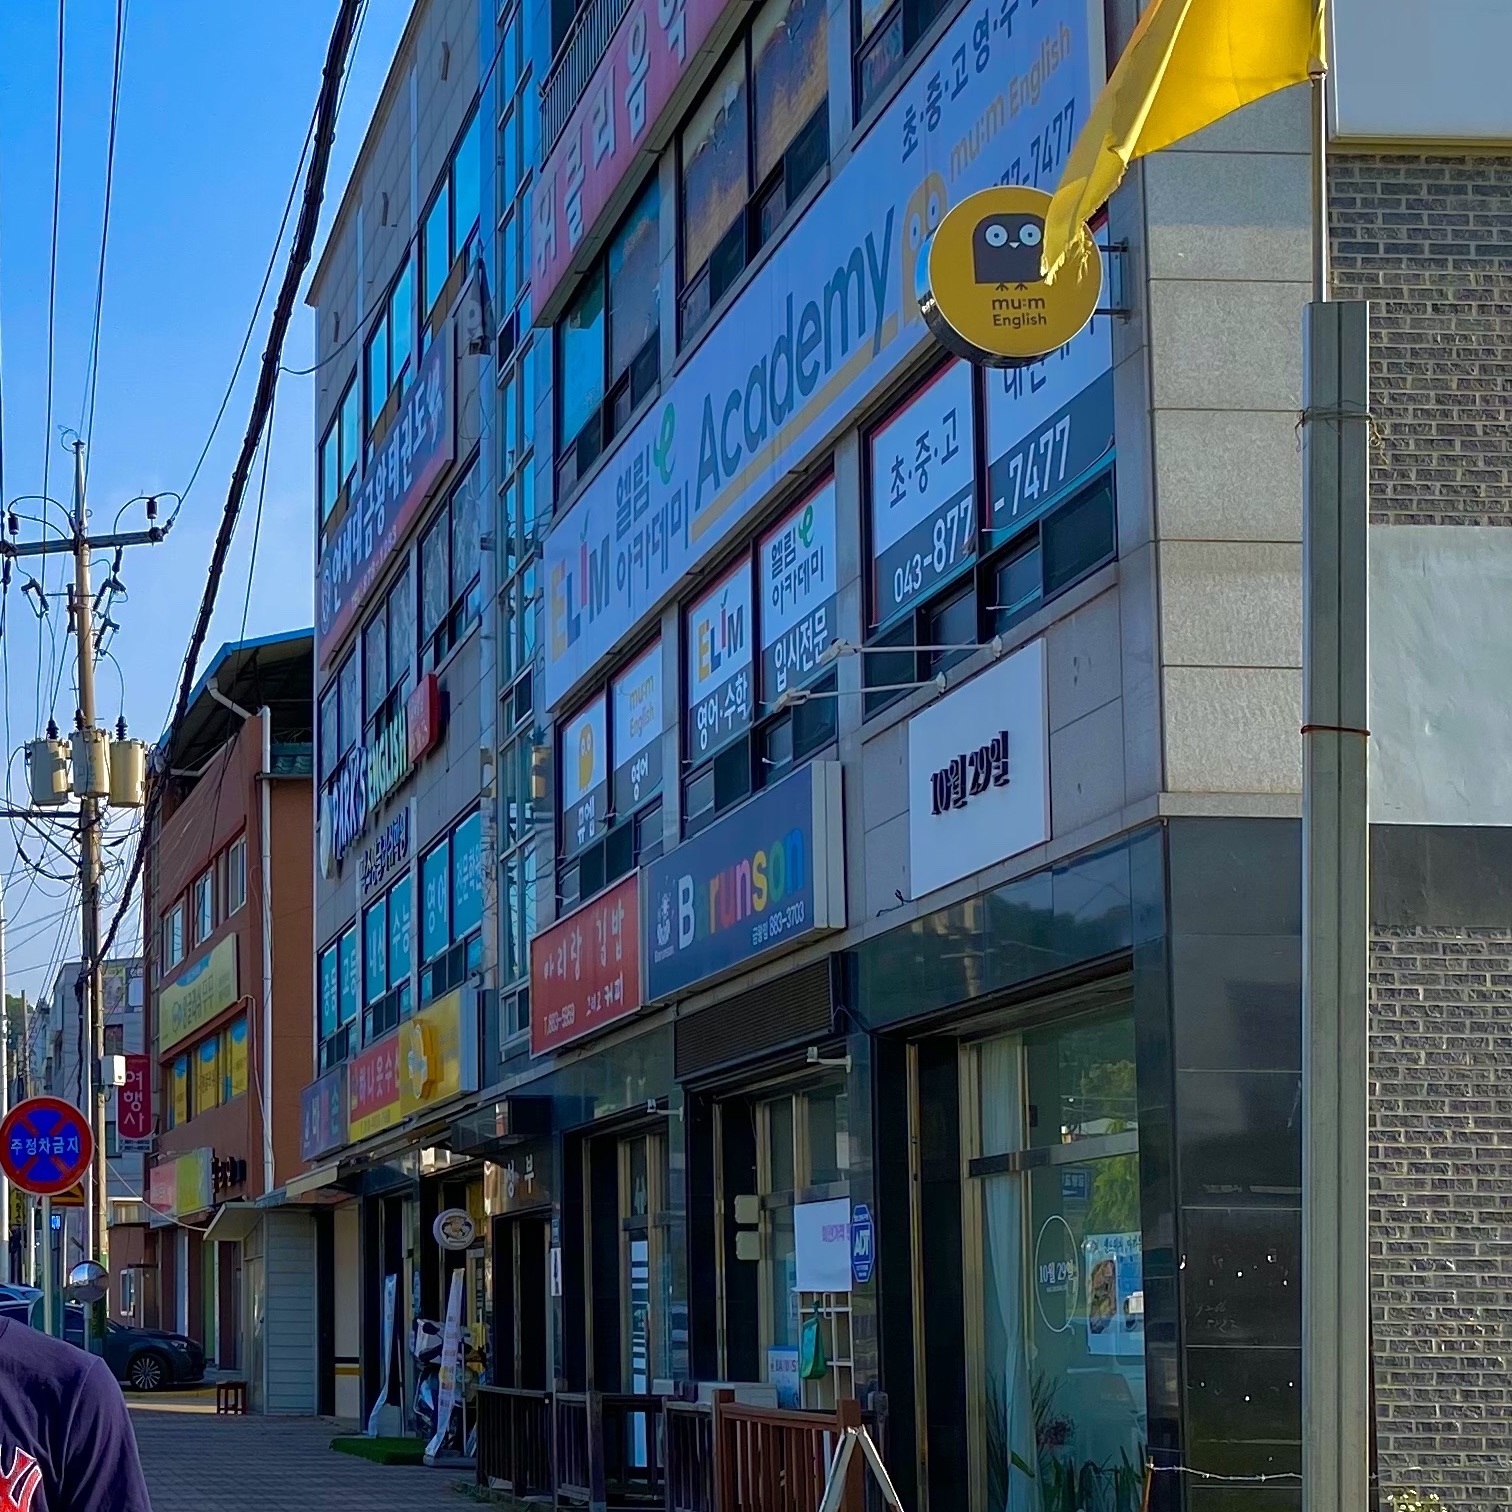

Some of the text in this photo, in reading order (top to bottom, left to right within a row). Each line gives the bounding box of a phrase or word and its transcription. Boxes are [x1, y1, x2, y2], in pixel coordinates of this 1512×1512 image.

[1009, 21, 1071, 119] English
[992, 297, 1045, 310] mu:m
[993, 314, 1047, 329] English
[695, 206, 895, 513] Academy
[616, 444, 650, 542] 엘림
[616, 480, 689, 608] 아카데미
[771, 526, 796, 580] 엘림
[895, 495, 973, 603] 043-877
[772, 546, 825, 615] 아카데미
[774, 607, 828, 693] 입시전문
[368, 706, 408, 813] ENGLISH
[631, 752, 649, 801] 영어
[930, 731, 1010, 815] 10월 29일
[427, 868, 448, 934] 영어
[678, 828, 806, 950] Barunson
[392, 904, 410, 960] 수능
[544, 898, 625, 981] 아리랑 김밥
[123, 1070, 145, 1133] 여행사
[10, 1136, 80, 1156] 주정차금지
[853, 1229, 870, 1257] ADT
[1039, 1262, 1056, 1284] 10월
